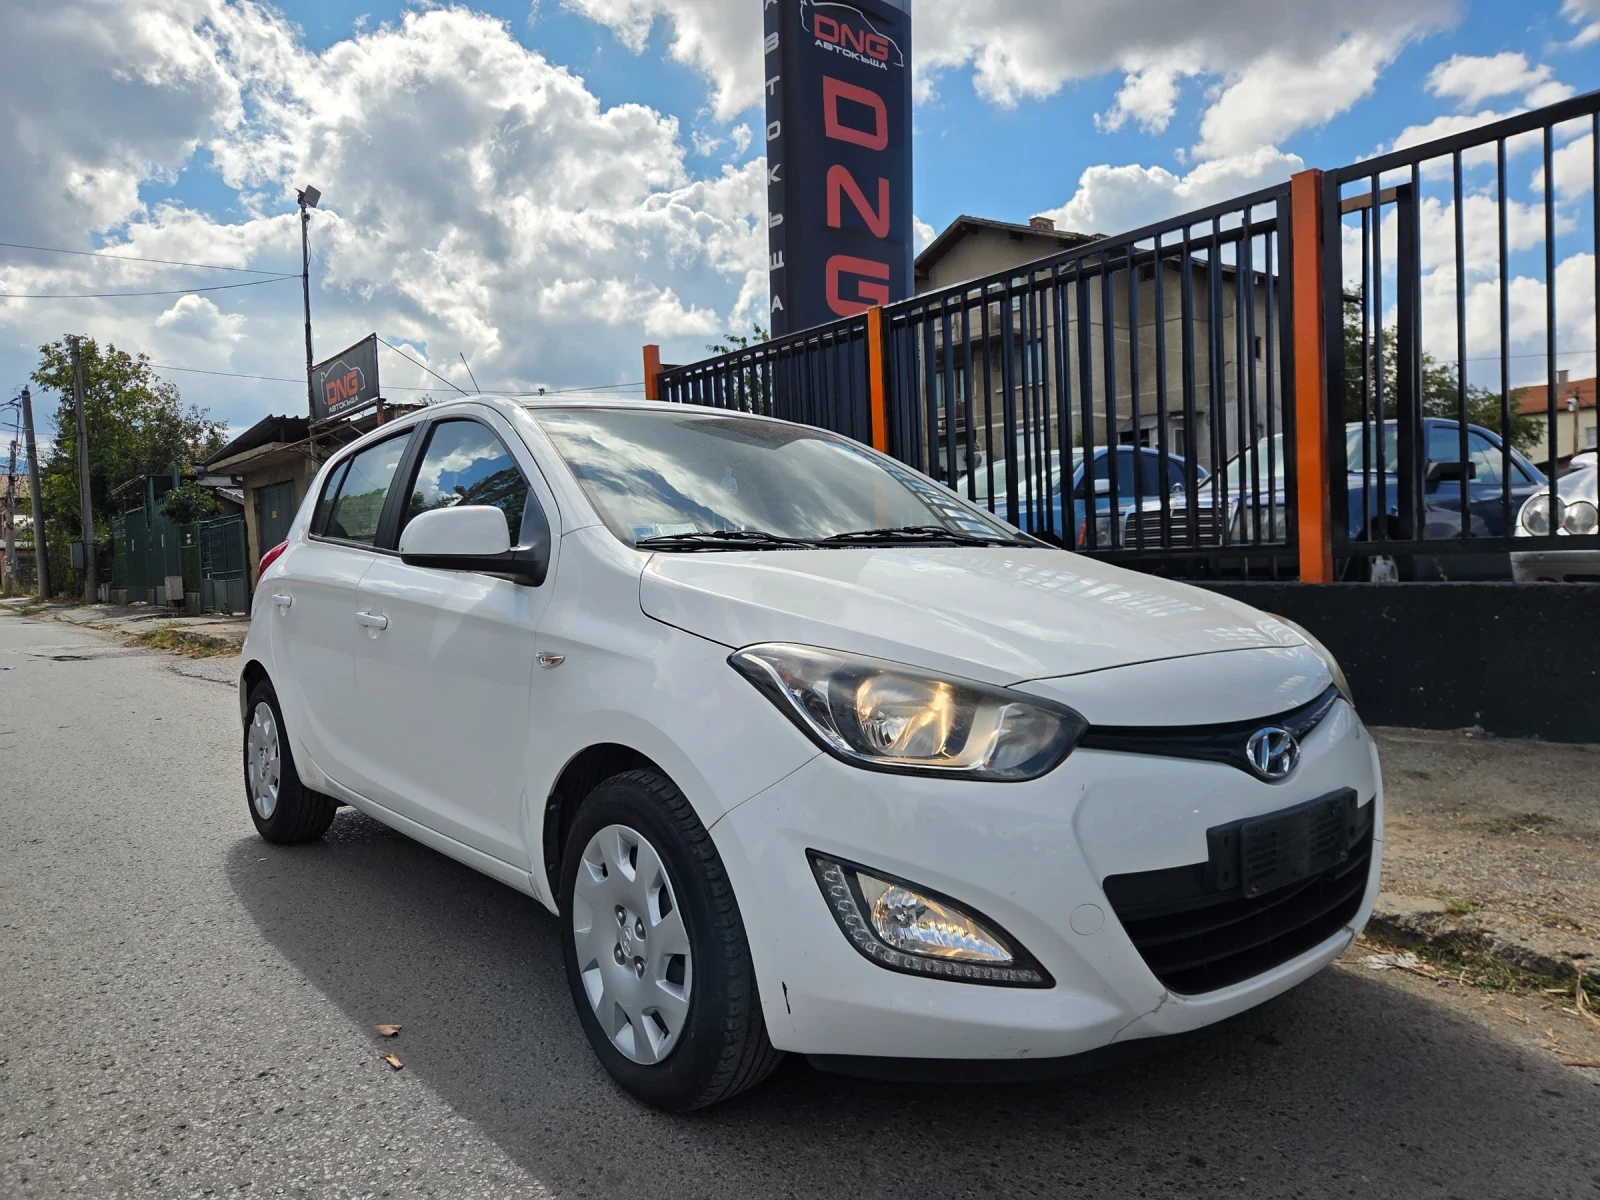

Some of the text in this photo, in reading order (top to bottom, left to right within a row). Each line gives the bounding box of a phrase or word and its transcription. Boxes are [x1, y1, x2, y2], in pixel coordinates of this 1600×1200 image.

[814, 12, 889, 62] DNG
[822, 75, 889, 317] DNG
[326, 370, 357, 405] DNG
